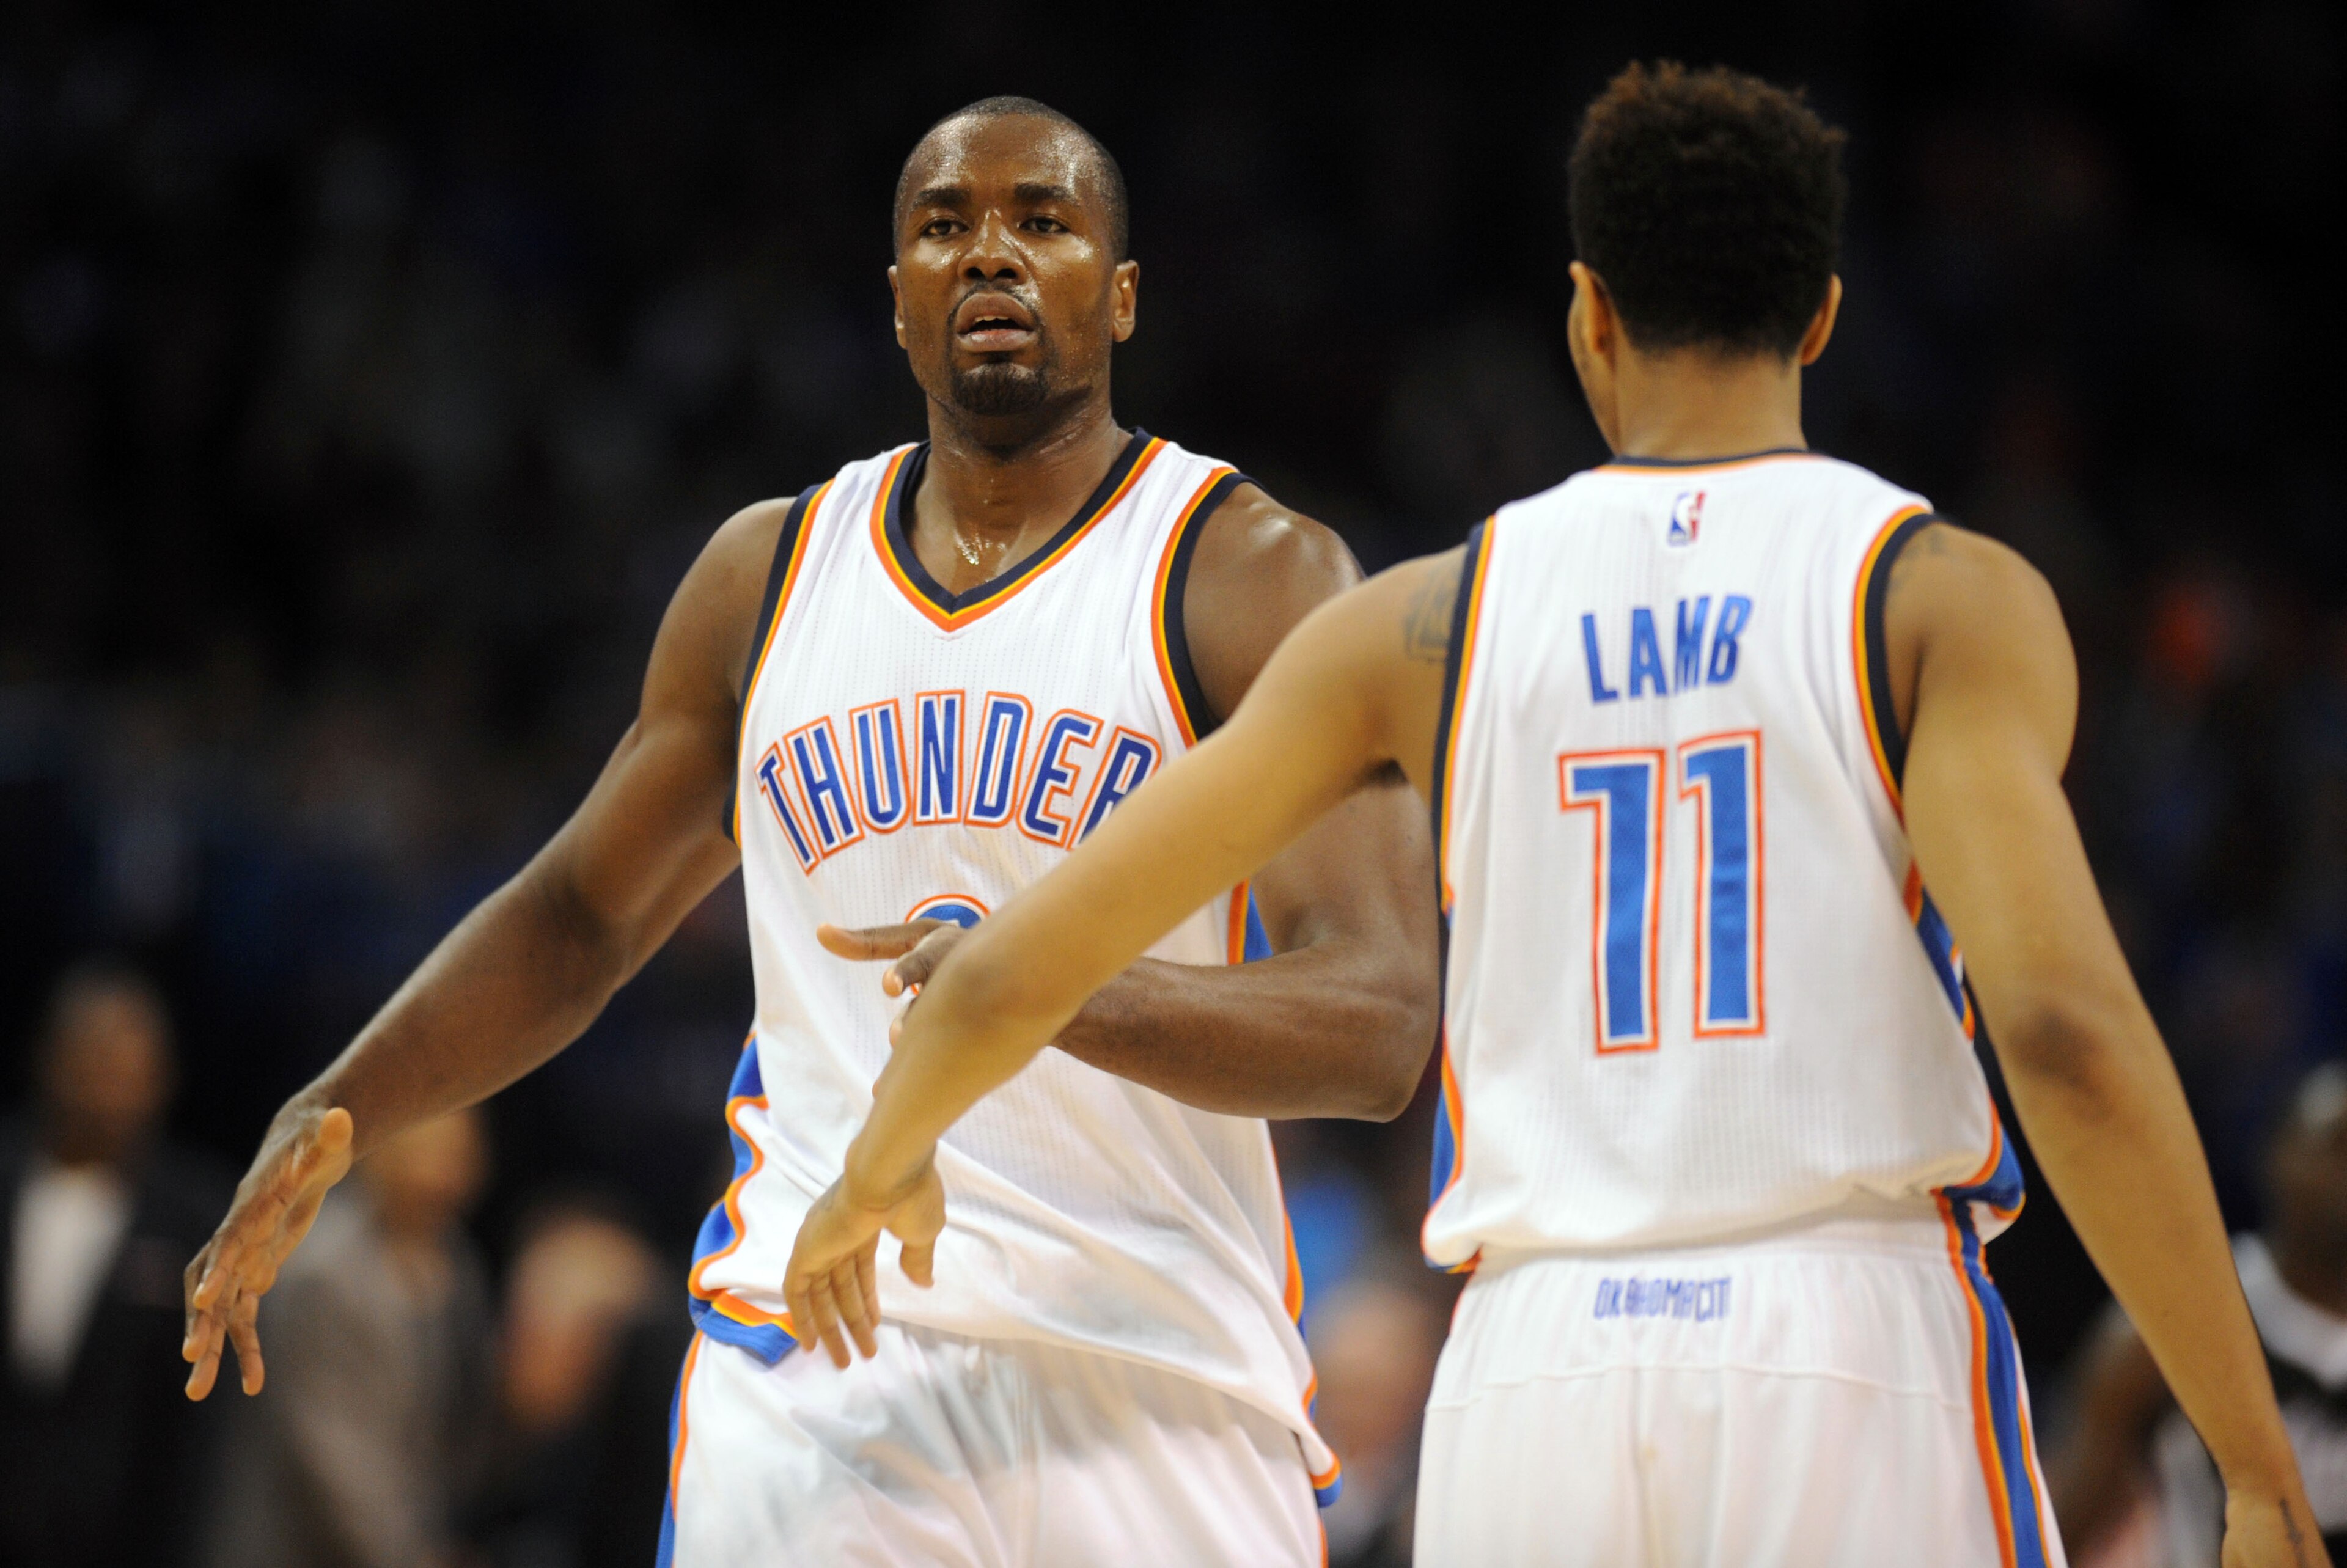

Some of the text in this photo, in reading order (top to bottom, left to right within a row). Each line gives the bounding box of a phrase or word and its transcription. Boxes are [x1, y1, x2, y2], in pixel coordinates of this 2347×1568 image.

[1581, 595, 1752, 705] LAMB
[755, 689, 1161, 876] THUNDER
[1557, 730, 1765, 1055] 11
